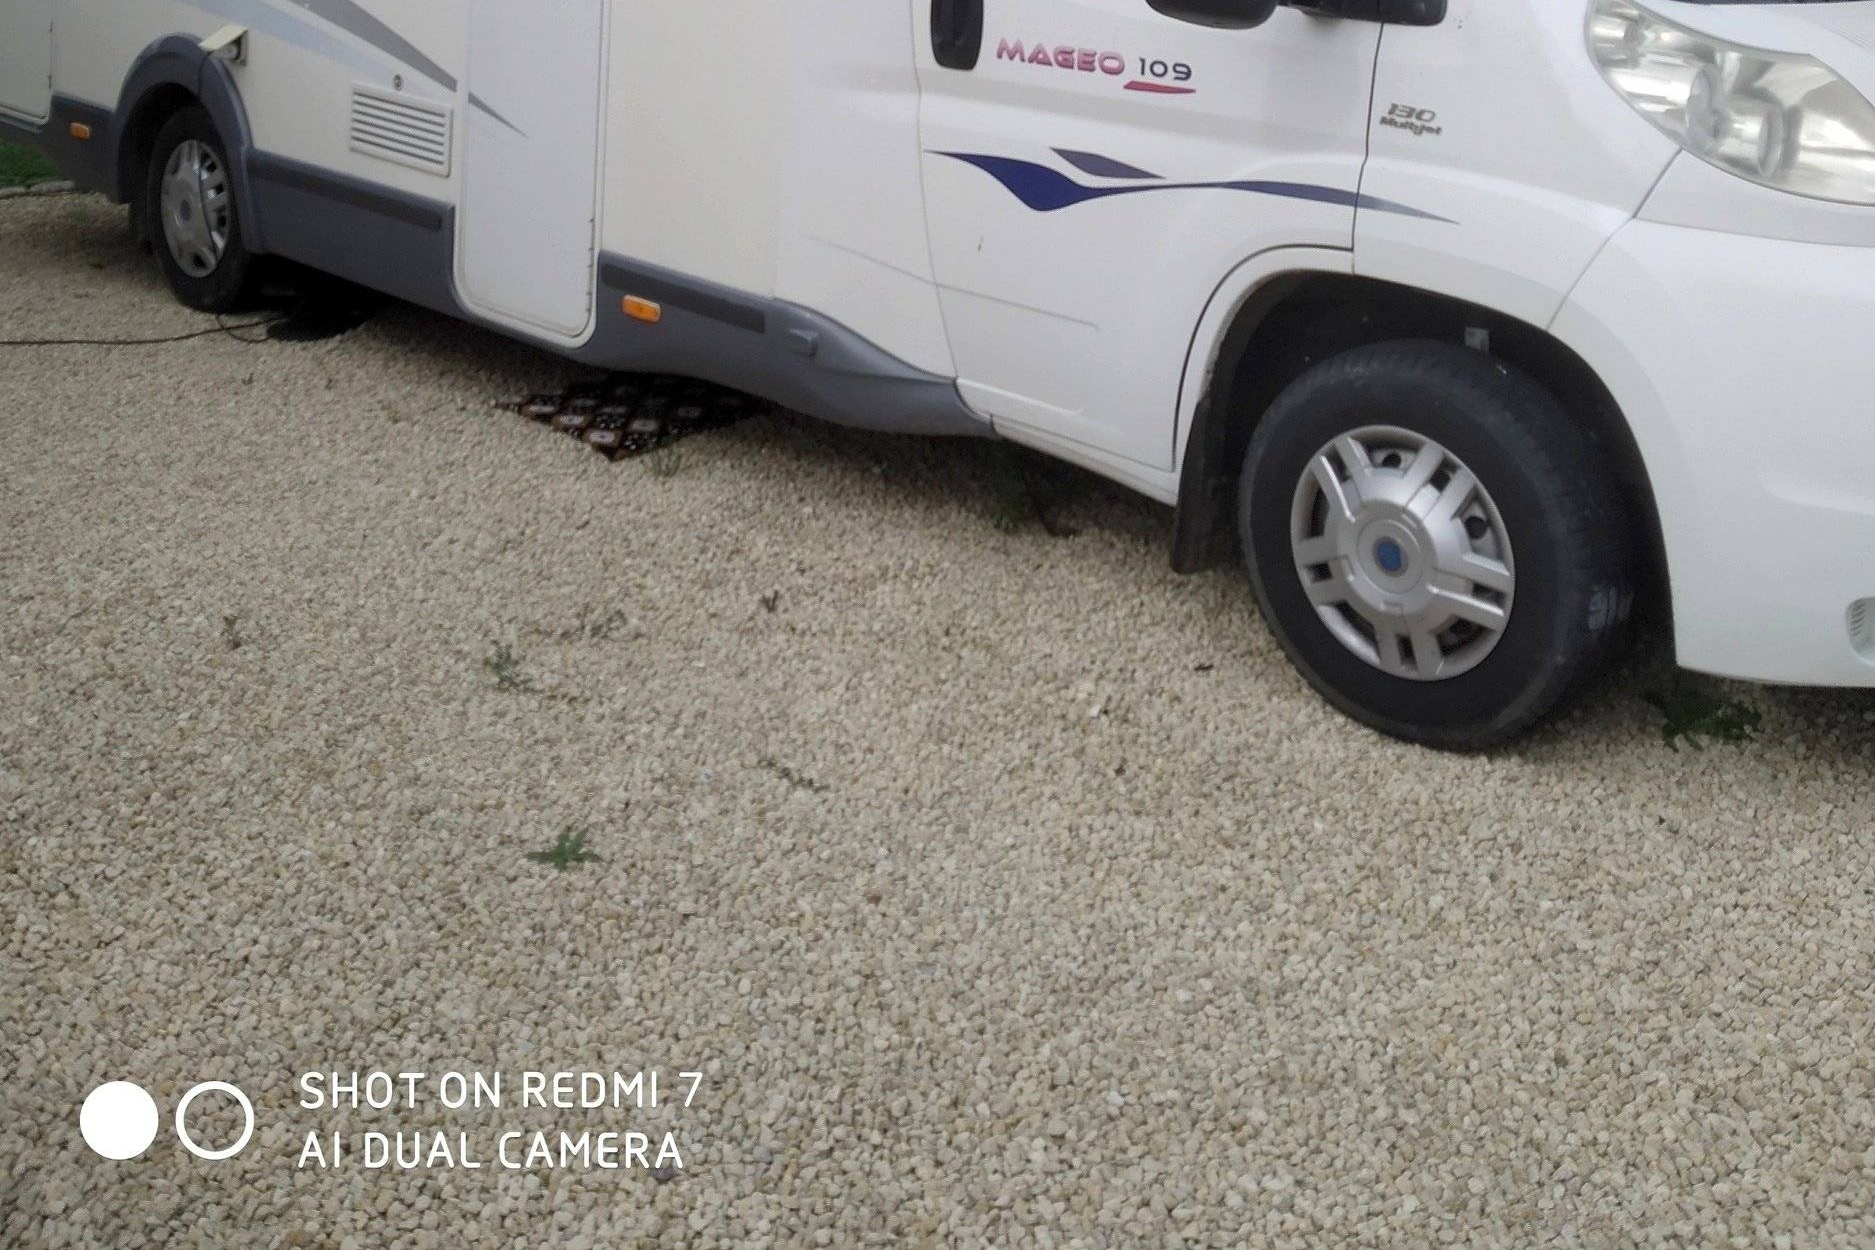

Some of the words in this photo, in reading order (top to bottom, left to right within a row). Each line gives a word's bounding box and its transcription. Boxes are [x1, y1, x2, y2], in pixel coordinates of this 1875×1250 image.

[996, 37, 1126, 76] MAGEO
[1139, 56, 1193, 81] 109
[1387, 102, 1436, 122] 130
